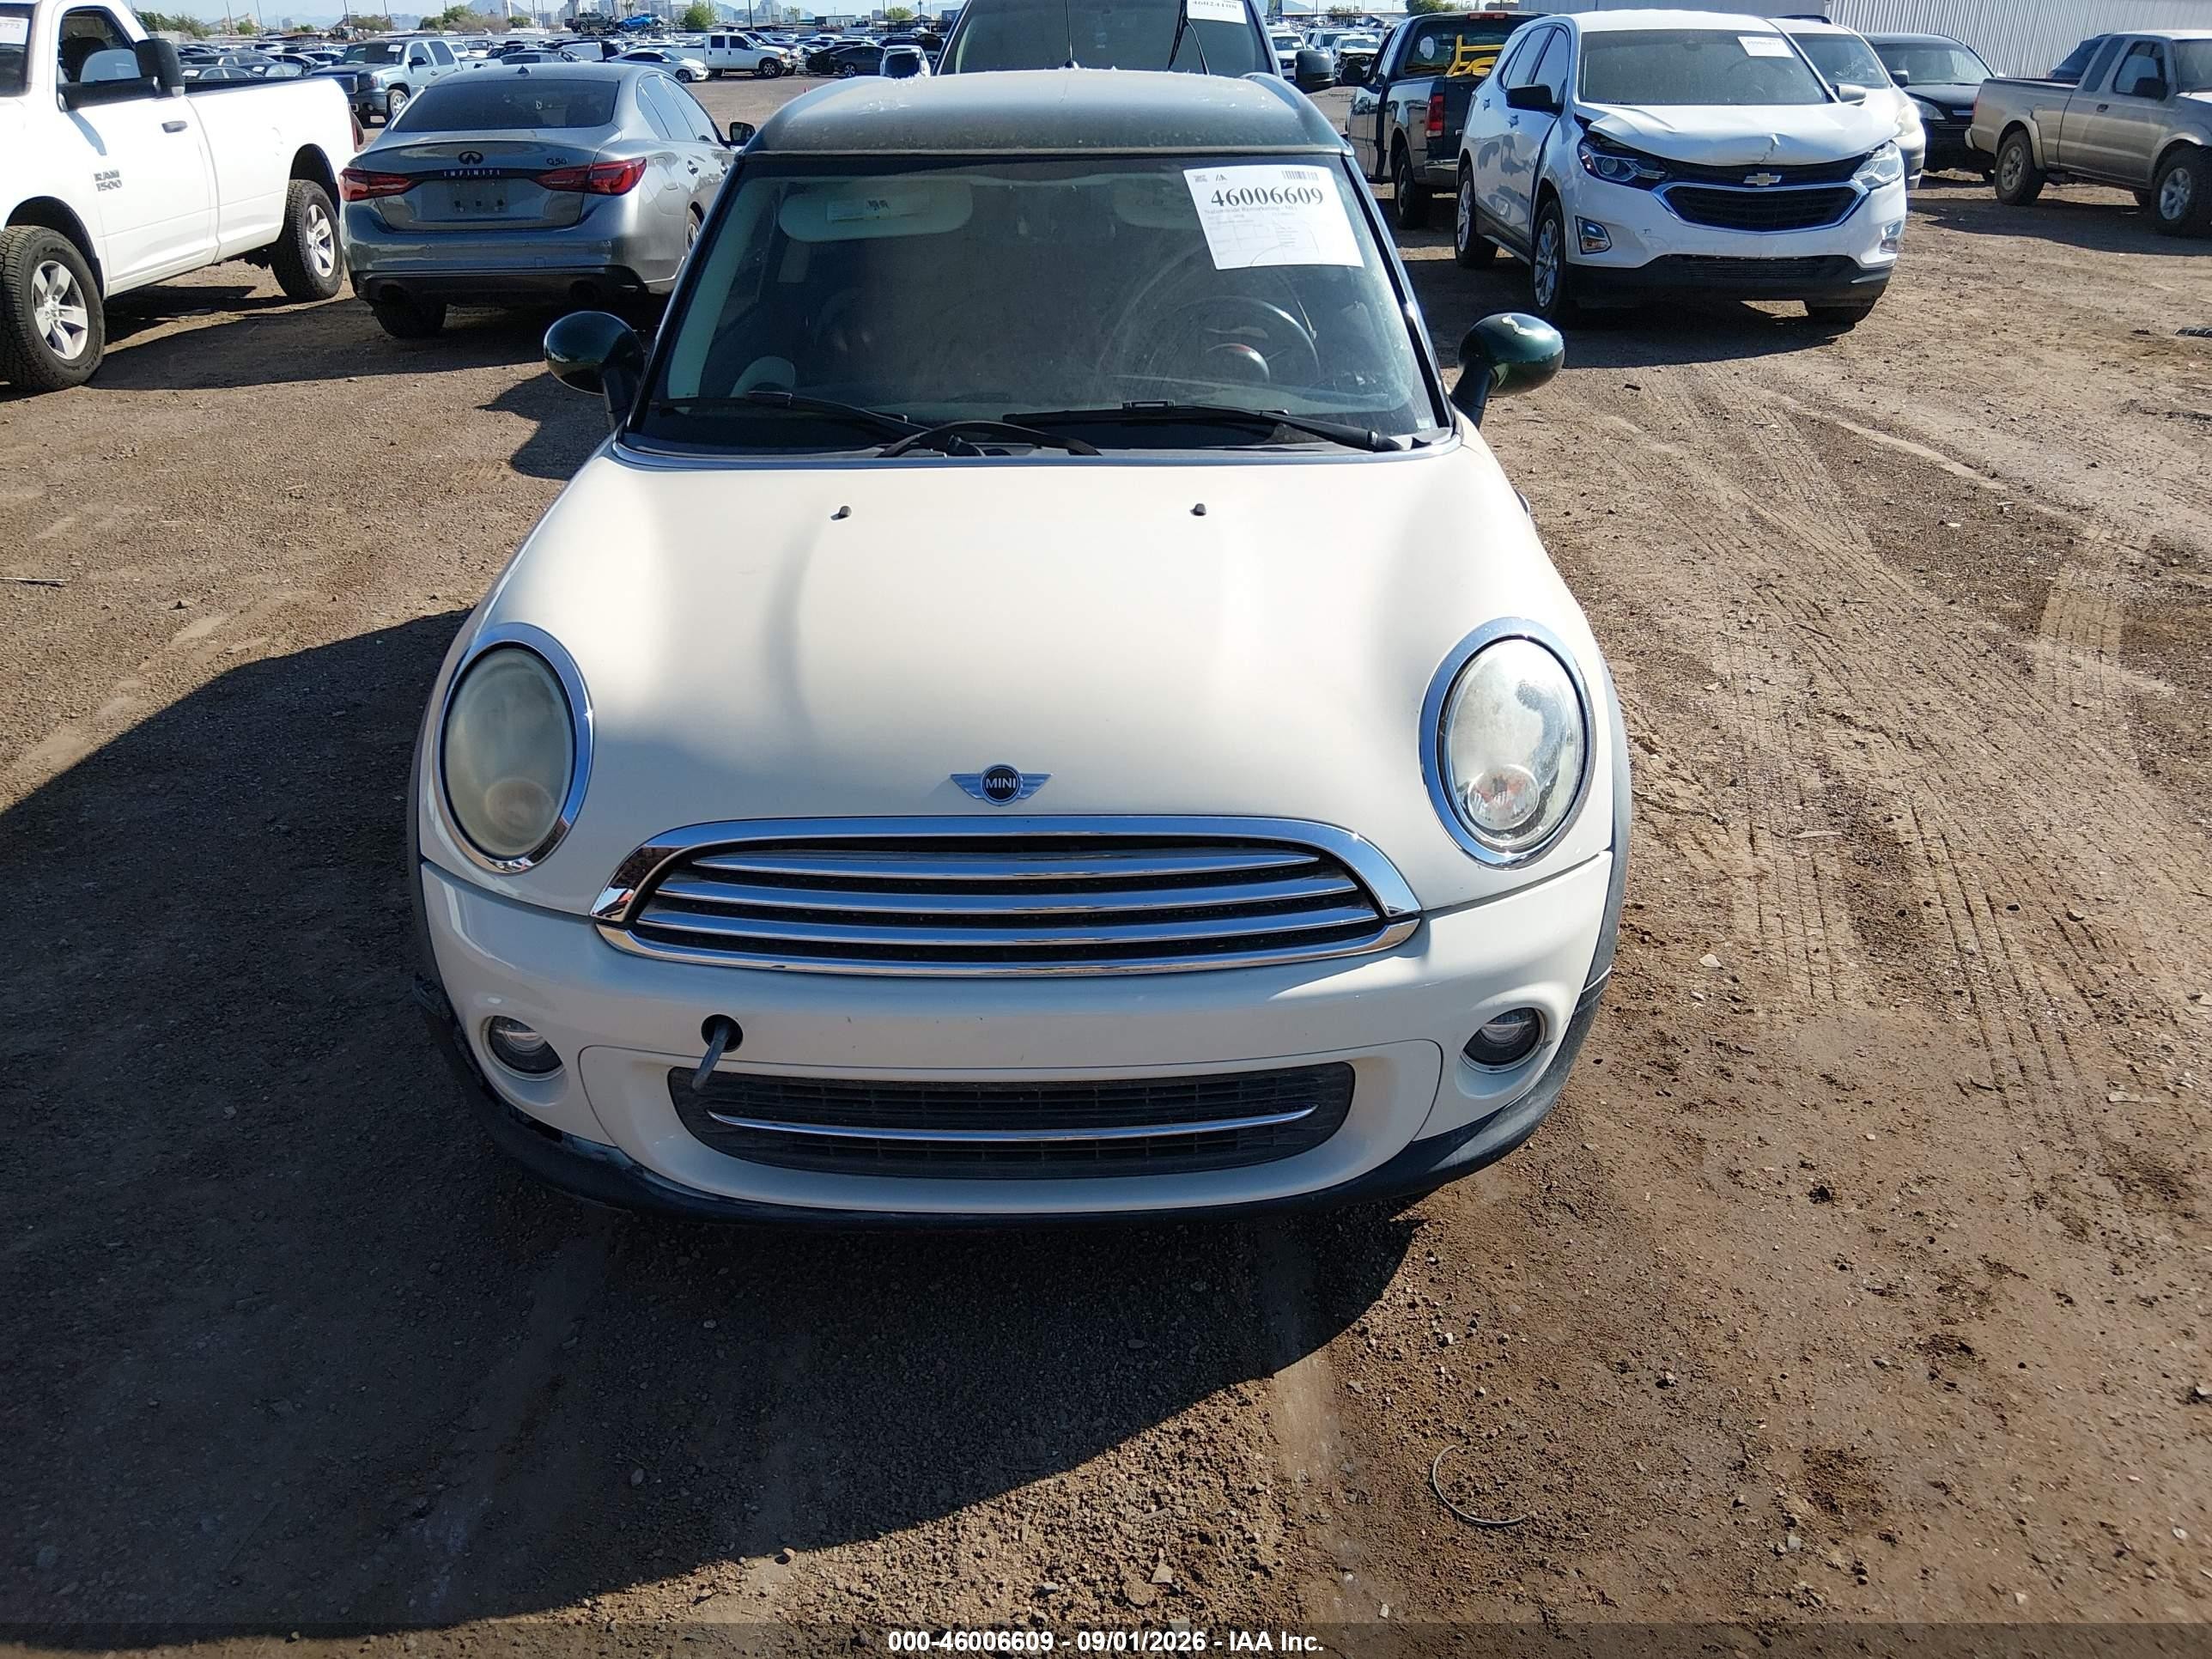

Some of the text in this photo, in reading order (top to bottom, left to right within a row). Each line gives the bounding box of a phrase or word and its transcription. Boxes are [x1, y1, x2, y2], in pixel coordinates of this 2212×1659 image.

[546, 157, 568, 167] Q50
[94, 170, 119, 181] RAM
[96, 179, 122, 191] 1500
[1211, 186, 1323, 206] 46006609
[986, 777, 1017, 789] MINI
